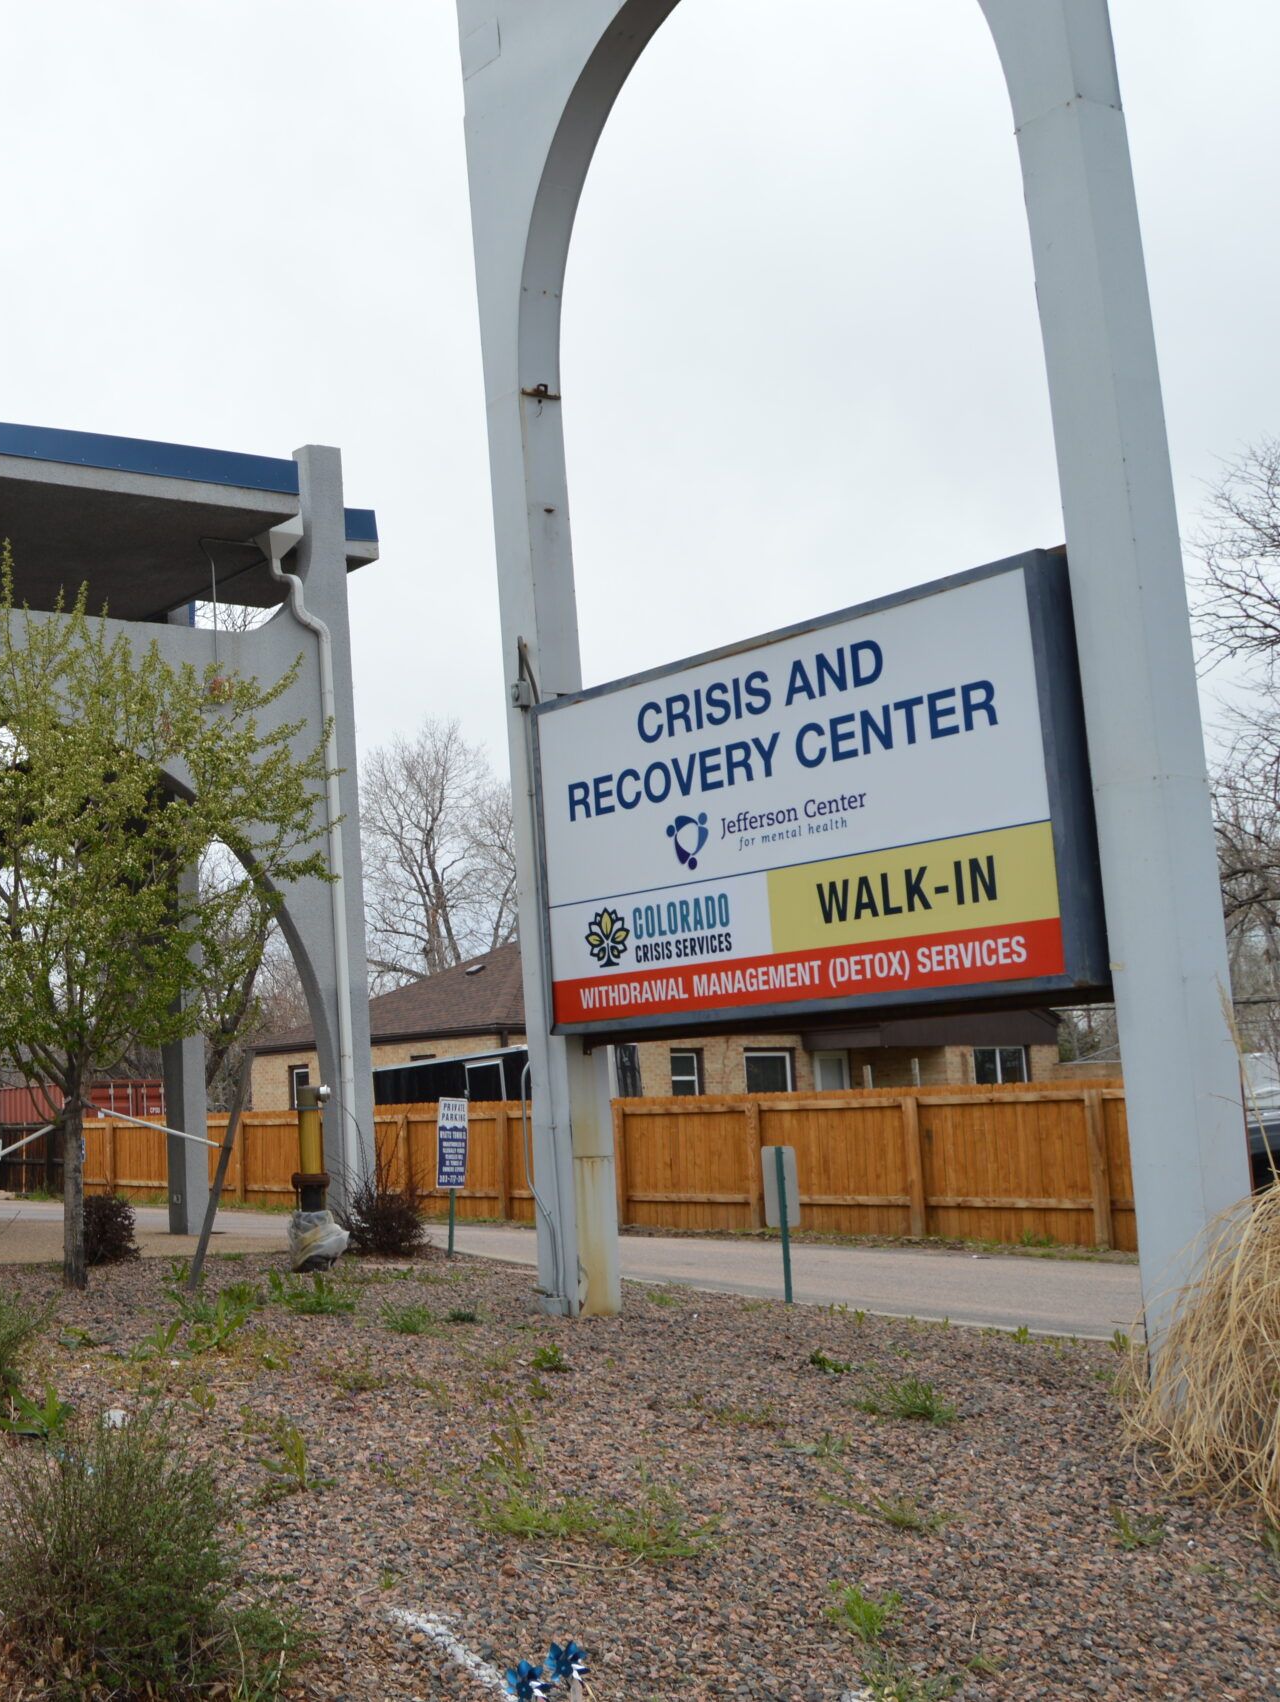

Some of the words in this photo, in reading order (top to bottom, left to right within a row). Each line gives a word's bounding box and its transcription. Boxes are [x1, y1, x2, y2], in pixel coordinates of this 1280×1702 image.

[637, 670, 772, 744] CRISIS
[785, 639, 884, 707] AND
[567, 731, 781, 822] RECOVERY
[795, 679, 999, 769] CENTER
[721, 806, 799, 840] Jefferson
[804, 792, 867, 818] Center
[738, 835, 756, 851] for
[761, 826, 802, 844] mental
[808, 816, 848, 835] health
[816, 855, 998, 924] WALK-IN
[632, 893, 731, 940] COLORADO
[635, 940, 673, 963] CRISIS
[675, 932, 733, 958] SERVICES
[579, 976, 689, 1010] WITHDRAWAL
[692, 960, 822, 998] MANAGEMENT
[828, 949, 911, 988] (DETOX)
[917, 935, 1027, 974] SERVICES
[442, 1113, 466, 1122] PARKING
[444, 1103, 465, 1112] PRIVATE
